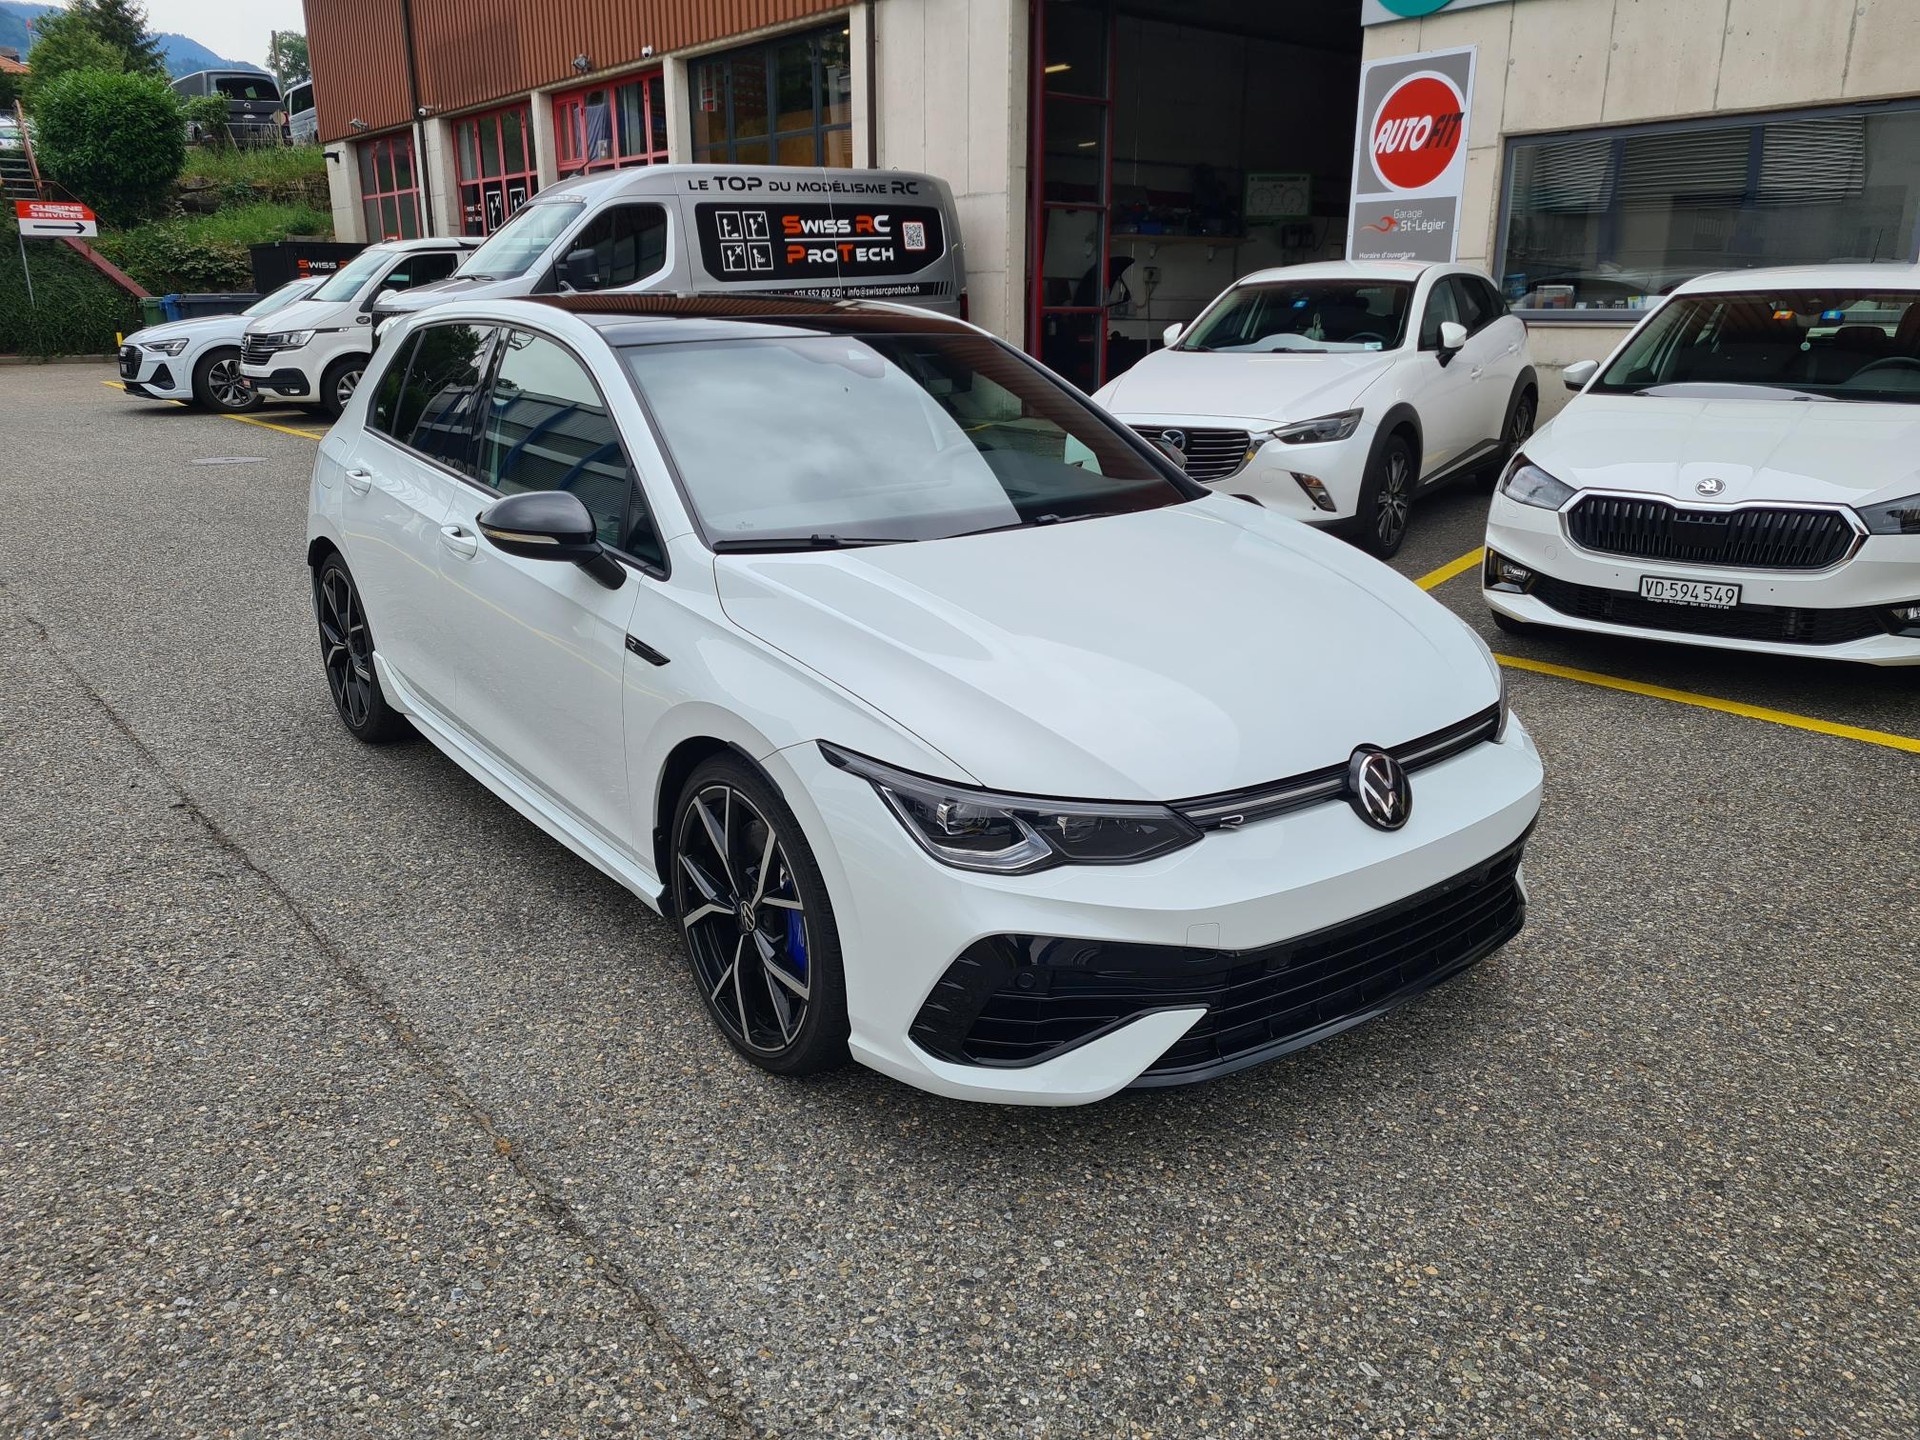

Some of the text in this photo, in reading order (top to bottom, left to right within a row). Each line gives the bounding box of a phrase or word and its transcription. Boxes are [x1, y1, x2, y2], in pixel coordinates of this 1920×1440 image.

[688, 176, 919, 195] LE TOP DU MODÉLISME RC
[28, 204, 83, 212] CUISINE
[1393, 208, 1423, 221] Garage
[855, 214, 891, 233] RC
[1400, 218, 1446, 233] St-Légier
[1359, 251, 1381, 259] Horaire
[821, 288, 830, 298] 60
[832, 287, 841, 297] 50
[847, 284, 920, 297] info@swissrcprotech.ch
